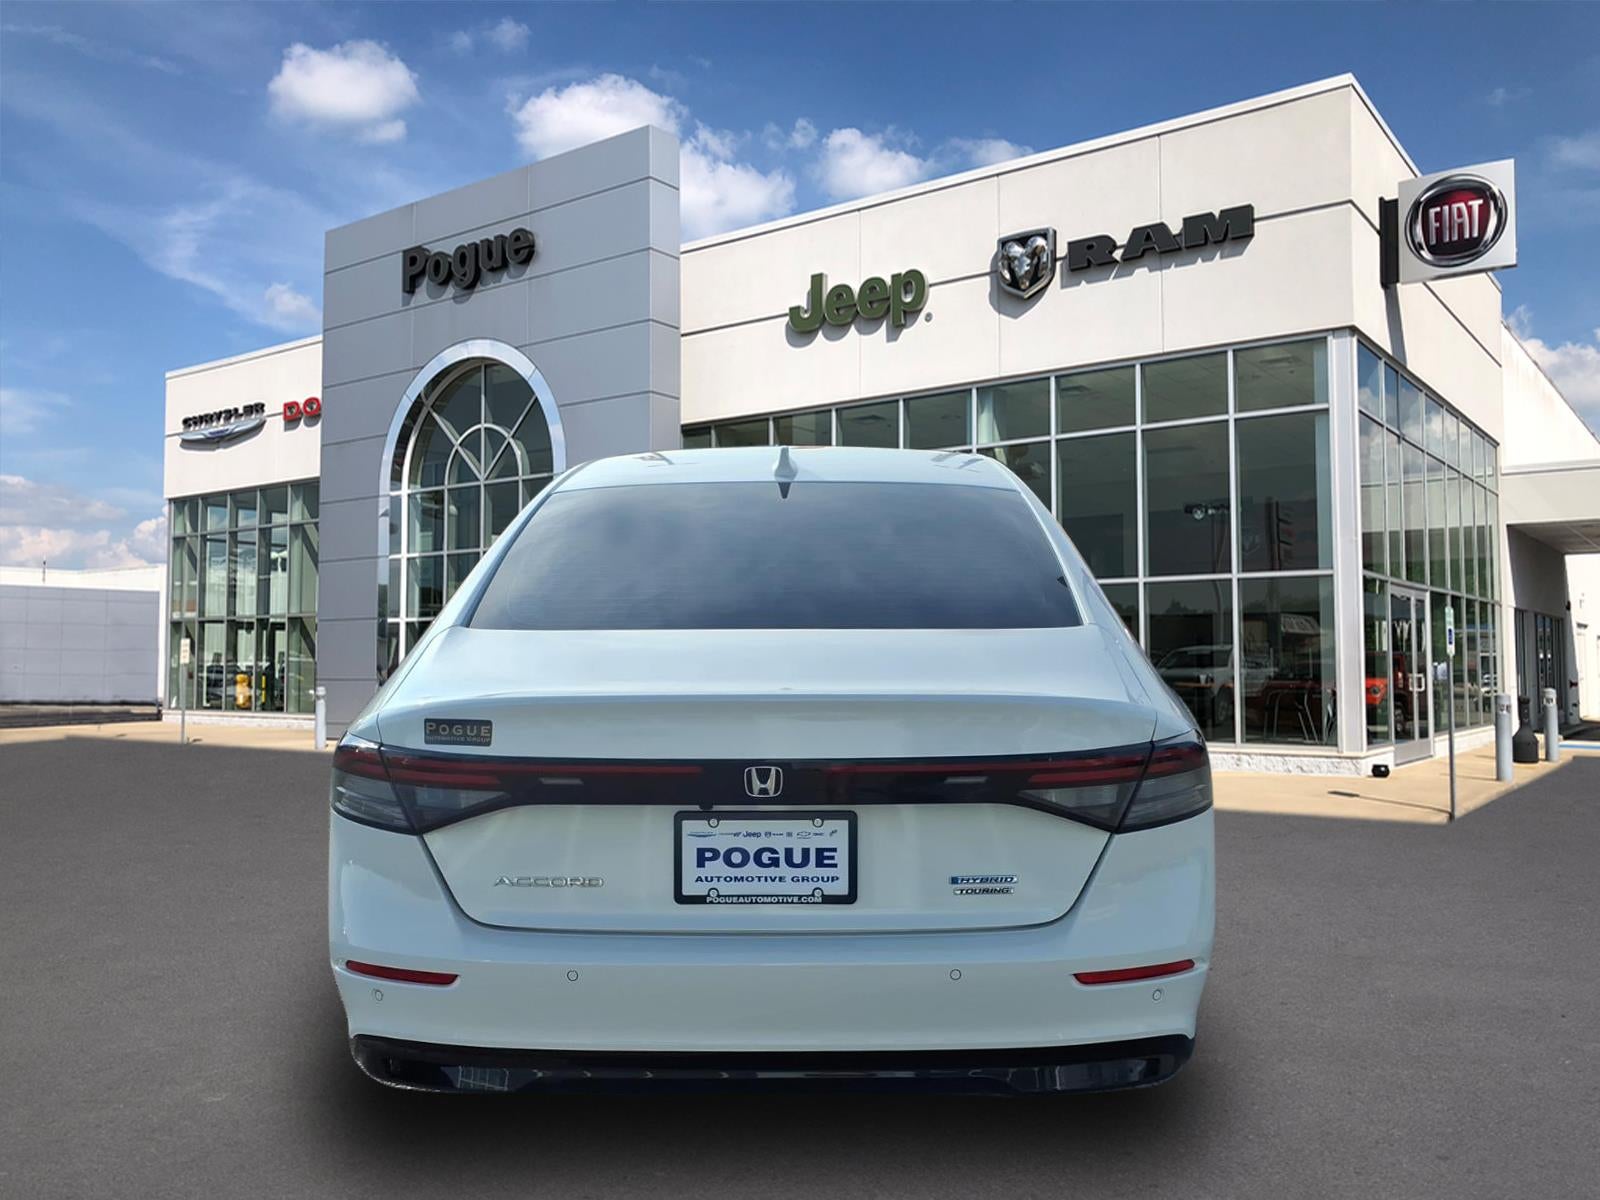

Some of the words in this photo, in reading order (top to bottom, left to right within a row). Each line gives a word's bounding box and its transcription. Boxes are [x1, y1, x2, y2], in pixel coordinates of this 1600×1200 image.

[1428, 199, 1484, 246] FIAT
[1067, 203, 1254, 271] RAM
[402, 228, 535, 294] Pogue
[788, 268, 927, 334] Jeep
[182, 402, 265, 429] CHRYSLER
[426, 722, 491, 736] POGUE
[696, 847, 838, 869] POGUE
[494, 876, 604, 888] ACCORD
[695, 875, 787, 883] AUTOMOTIVE
[791, 875, 839, 883] GROUP
[958, 875, 1017, 884] HYBRID
[706, 896, 822, 904] POGUEAUTOMOTIVE.COM
[957, 887, 1013, 895] TOURING
